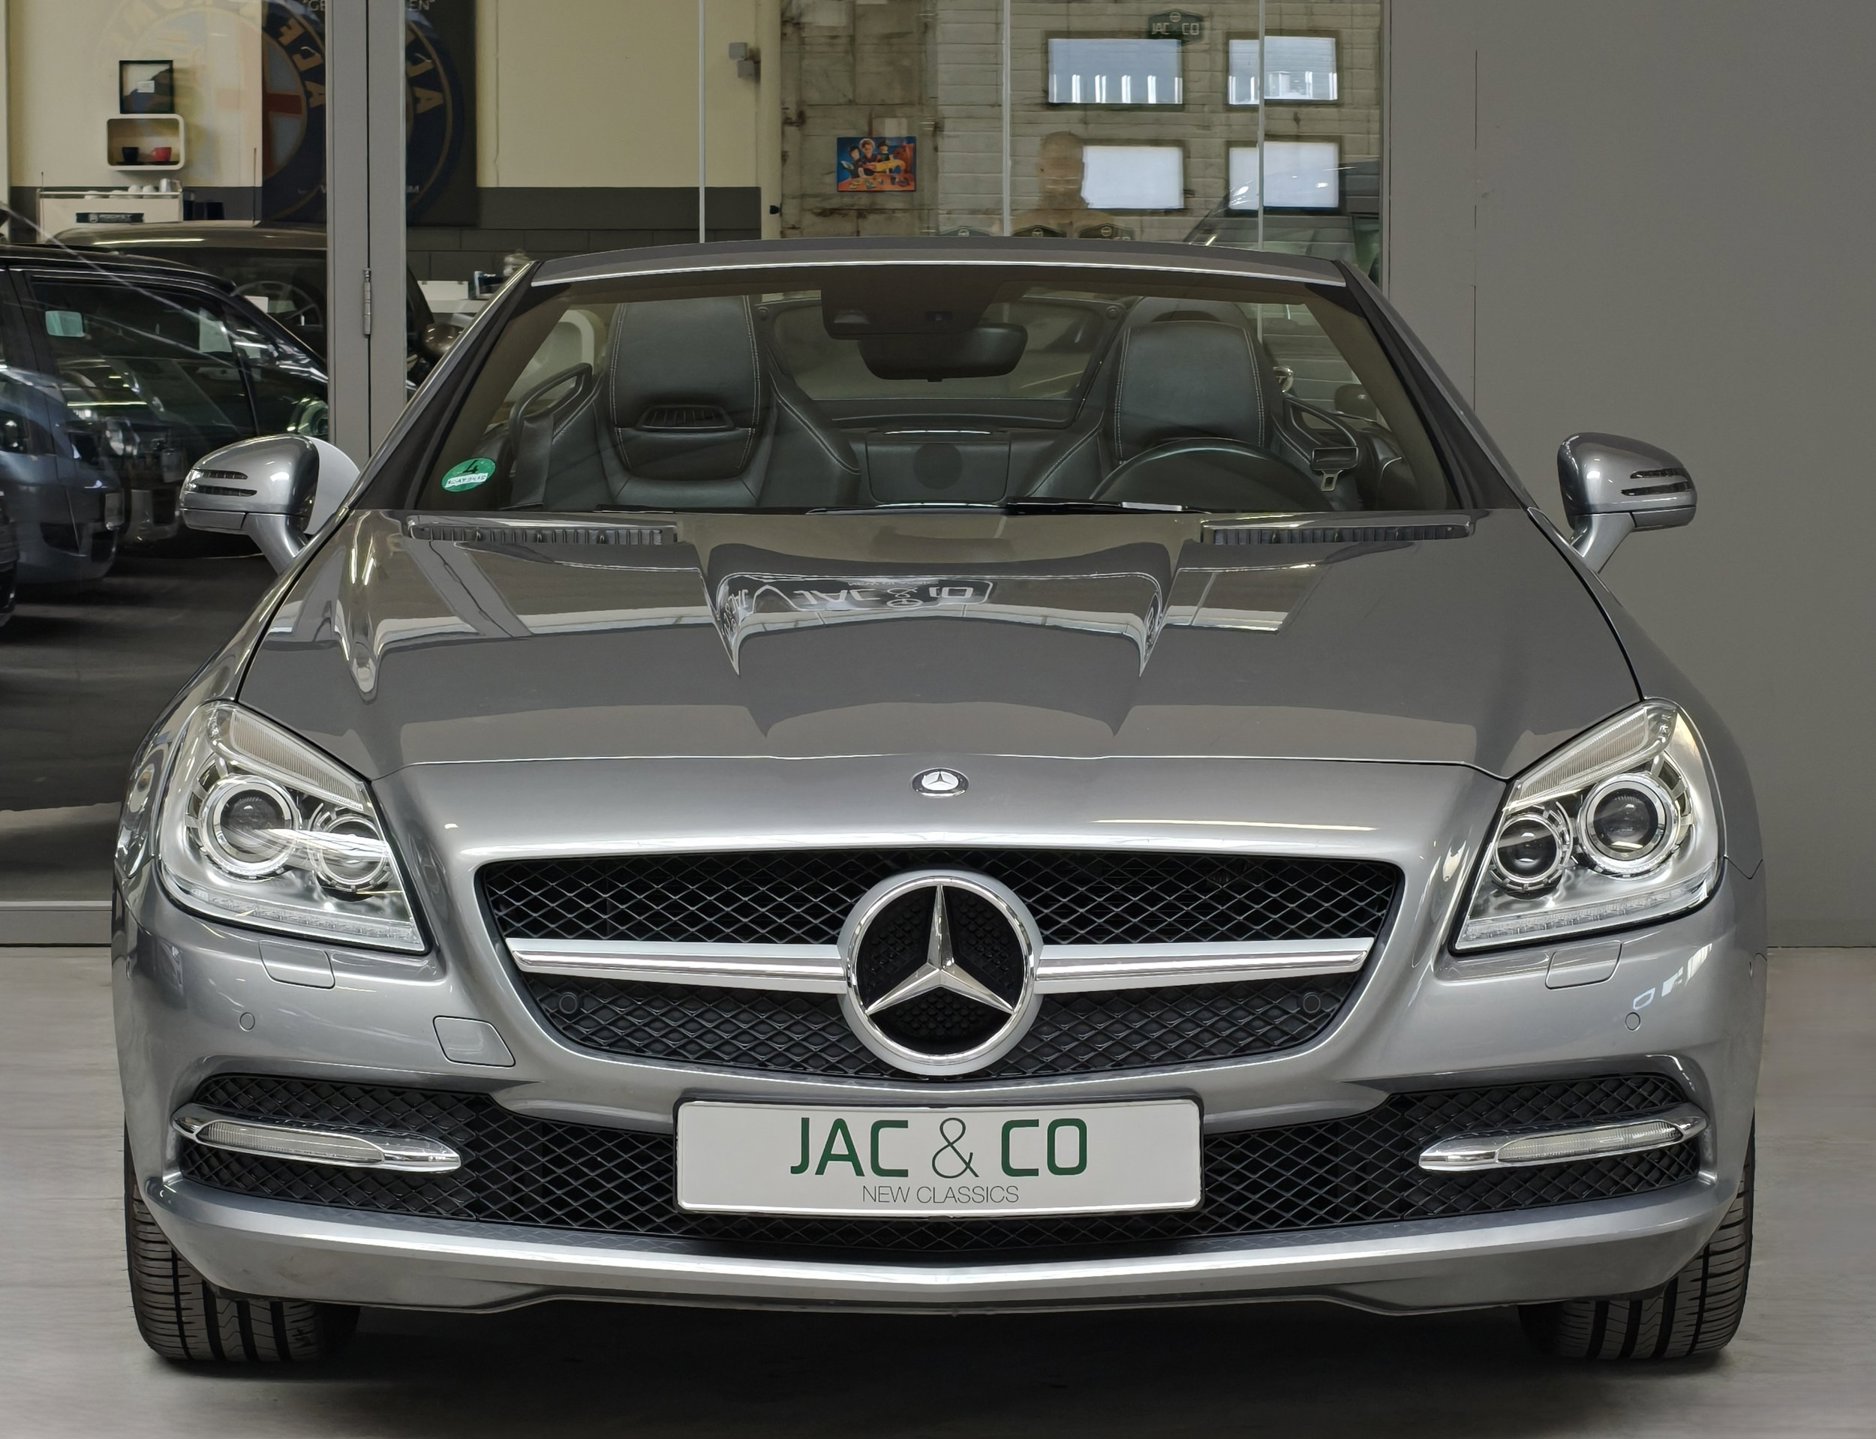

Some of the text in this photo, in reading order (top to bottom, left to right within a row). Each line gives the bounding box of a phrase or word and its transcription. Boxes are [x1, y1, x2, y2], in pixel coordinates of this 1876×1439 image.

[790, 1117, 1088, 1179] JAC & CO
[862, 1185, 1020, 1204] NEW CLASSICS
